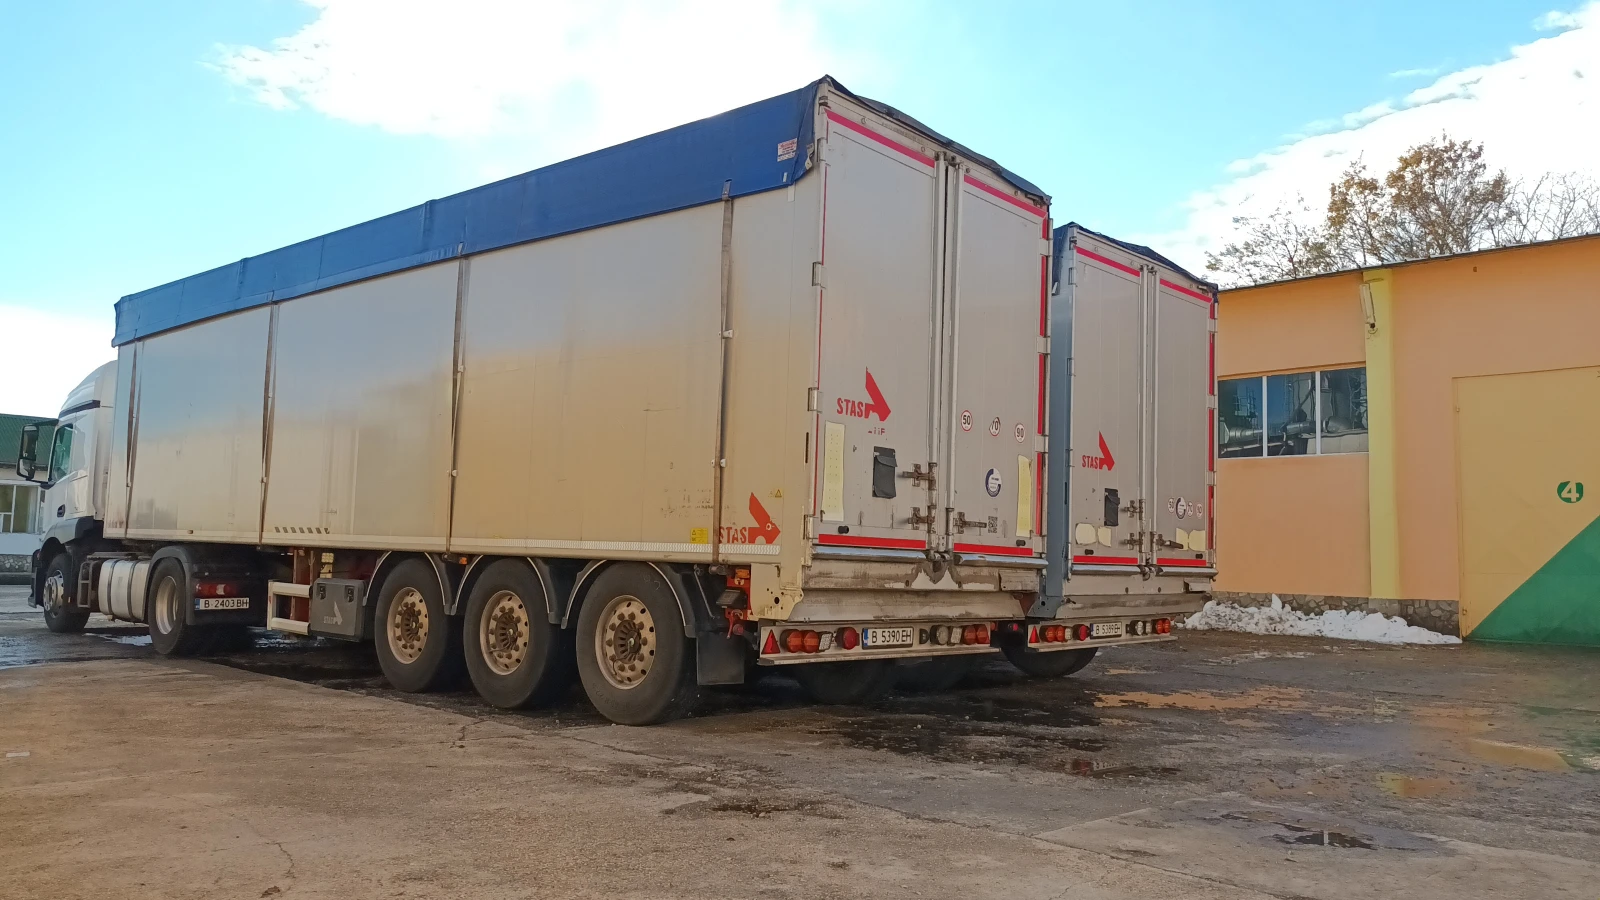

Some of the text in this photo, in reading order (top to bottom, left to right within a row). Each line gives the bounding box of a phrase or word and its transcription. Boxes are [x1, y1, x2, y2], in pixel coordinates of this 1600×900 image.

[836, 397, 864, 418] STAS
[962, 414, 971, 426] 50
[1016, 427, 1024, 438] 90
[1081, 454, 1099, 469] STAS
[1561, 480, 1580, 502] 4
[871, 630, 878, 644] B
